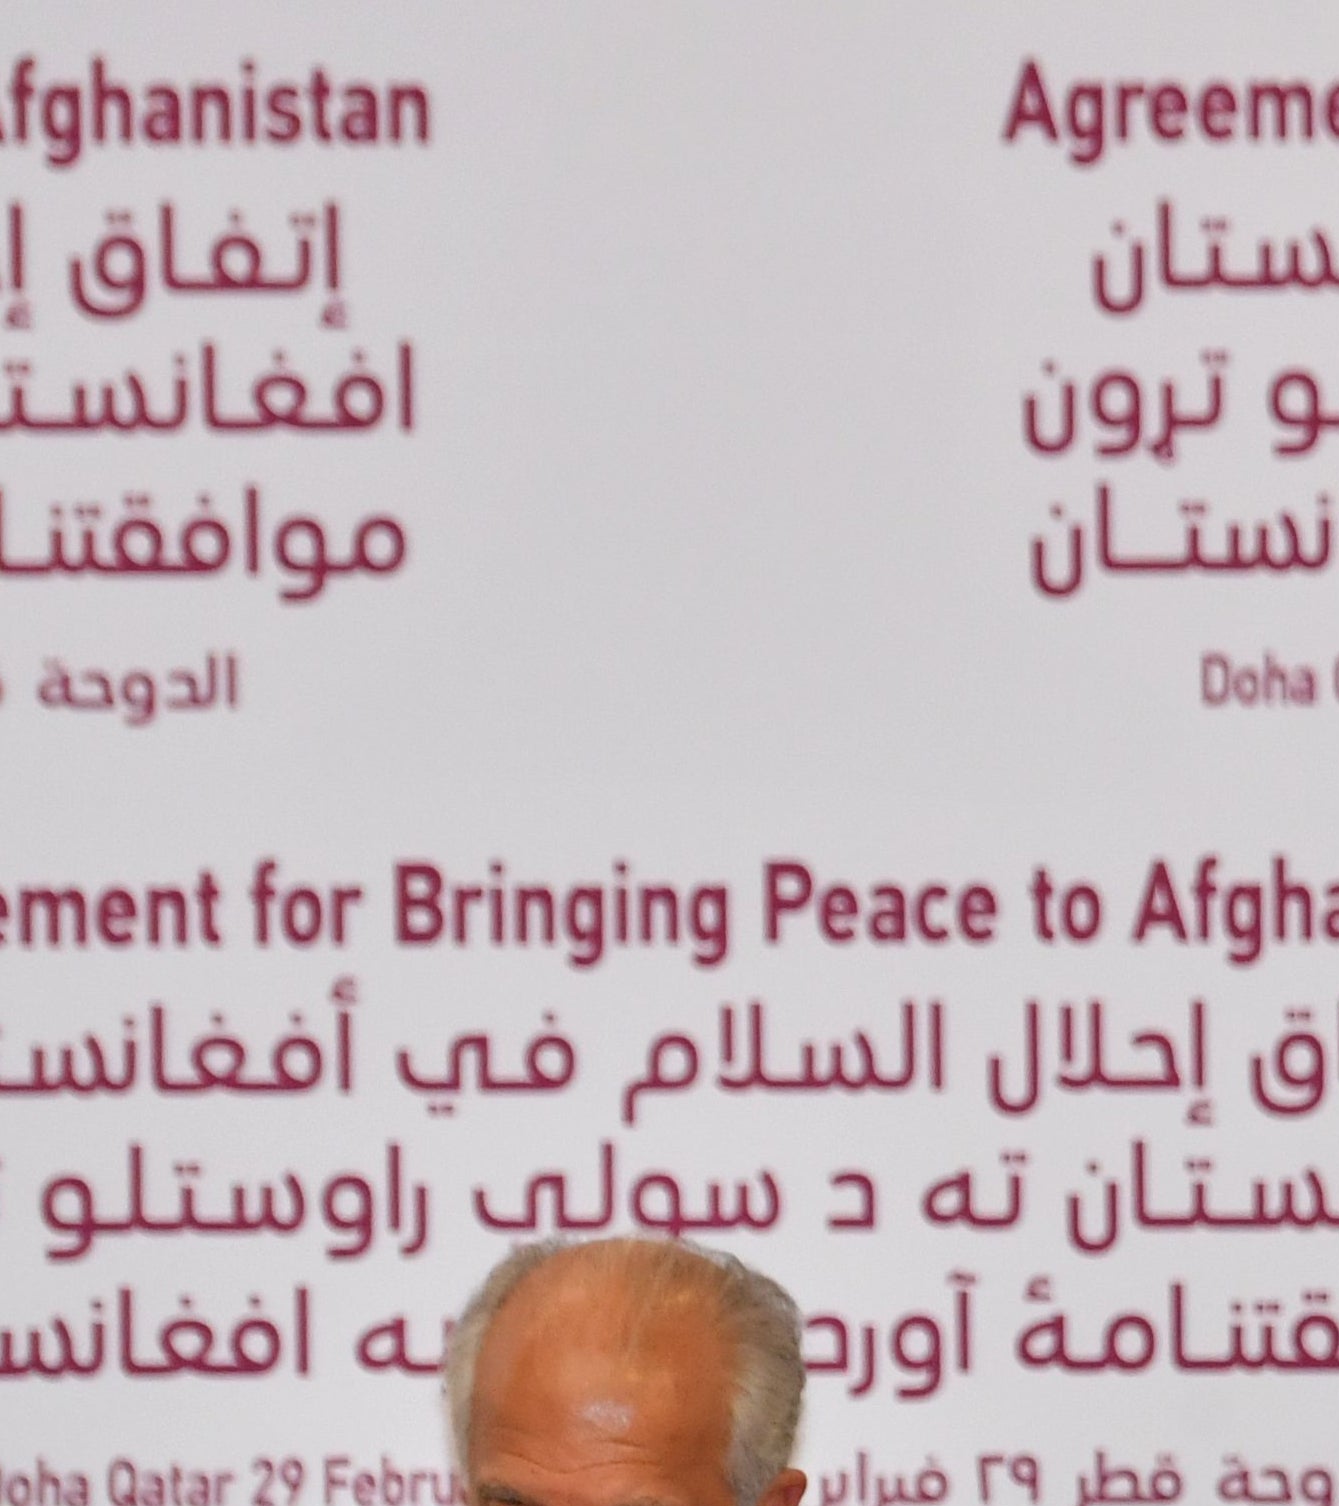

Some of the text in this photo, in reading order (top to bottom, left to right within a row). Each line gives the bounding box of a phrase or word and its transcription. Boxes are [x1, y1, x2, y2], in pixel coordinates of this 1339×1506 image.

[0, 341, 416, 435] افغانست
[39, 653, 238, 726] الدوحة
[1202, 652, 1319, 707] Doha
[251, 858, 364, 948] for
[395, 859, 732, 971] Bringing
[764, 857, 1001, 945] Peace
[1031, 867, 1104, 944] to
[0, 976, 357, 1097] أفغانس
[397, 1012, 579, 1116] في
[621, 999, 947, 1127] السلام
[988, 998, 1213, 1126] إحلال
[42, 1141, 430, 1262] راوستلو
[828, 1169, 879, 1231] د
[922, 1151, 1029, 1232] ته
[0, 1285, 312, 1380] افغانس
[804, 1270, 977, 1402] آورد
